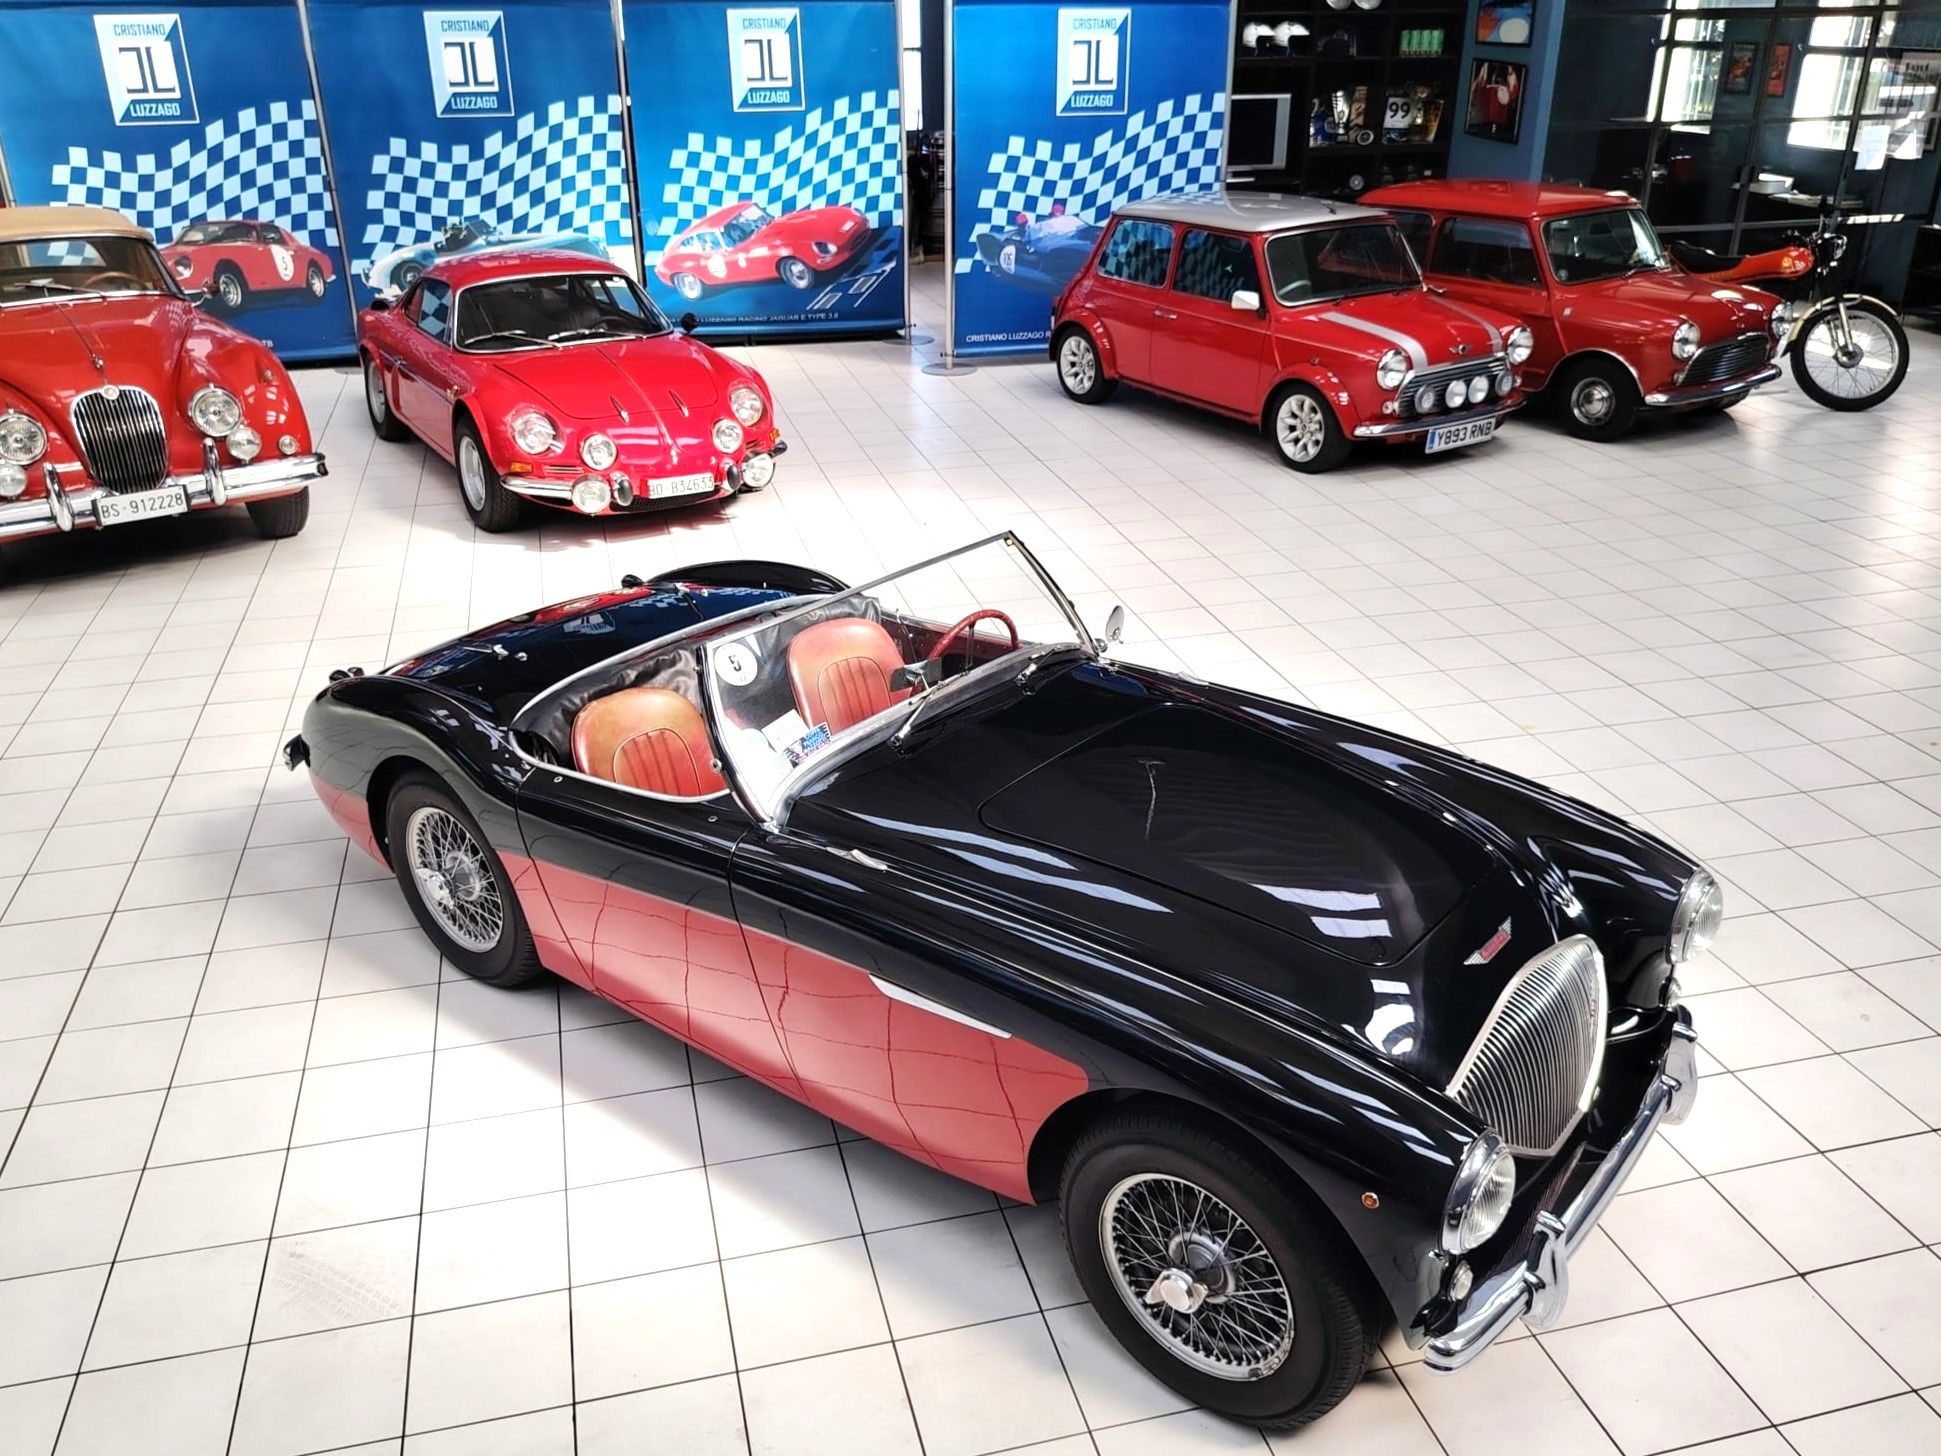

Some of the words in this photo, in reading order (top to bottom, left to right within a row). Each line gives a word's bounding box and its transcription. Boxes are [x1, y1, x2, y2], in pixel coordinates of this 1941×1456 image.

[113, 23, 167, 36] CRISTIANO
[441, 19, 490, 32] CRISTIANO
[742, 17, 787, 30] CRISTIANO
[1072, 17, 1118, 30] CRISTIANO
[450, 95, 498, 110] LUZZAGO
[747, 90, 791, 105] LUZZAGO
[1070, 94, 1114, 108] LUZZAGO
[129, 102, 181, 118] LUZZAGO
[1388, 101, 1411, 119] 99
[800, 313, 806, 321] E
[807, 312, 826, 320] TYPE
[965, 332, 1008, 343] CRISTIANO
[1008, 330, 1044, 341] LUZZAGO
[1437, 427, 1467, 446] Y893
[1469, 421, 1492, 439] RNB
